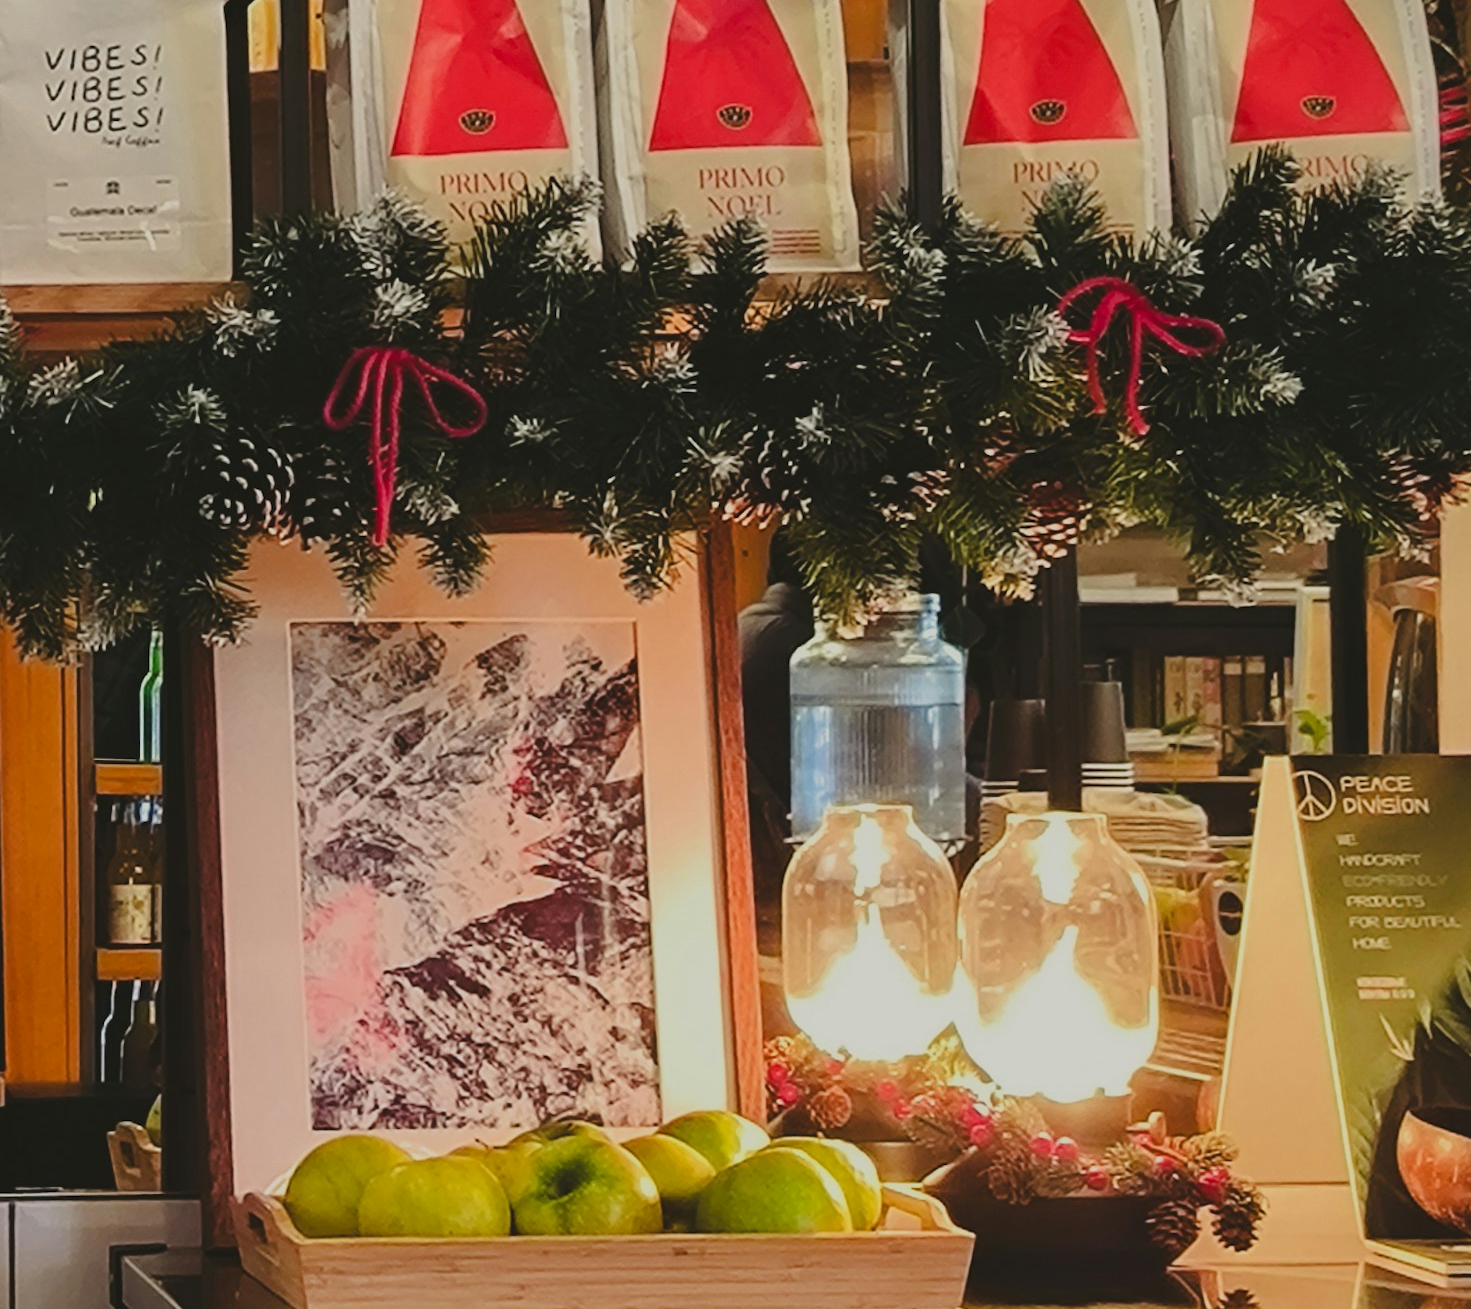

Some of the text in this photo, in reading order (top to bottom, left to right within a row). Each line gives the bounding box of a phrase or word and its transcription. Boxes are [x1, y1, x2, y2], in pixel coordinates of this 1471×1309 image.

[45, 44, 162, 72] VIBES!
[45, 76, 163, 103] VIBES!
[46, 106, 164, 134] VIBES!
[440, 171, 528, 194] PRIMO
[699, 166, 785, 189] PRIMO
[1339, 775, 1413, 793] PEACE
[1346, 895, 1426, 909] PRODUCTS
[1348, 915, 1463, 929] FOR BEAUTIFUL
